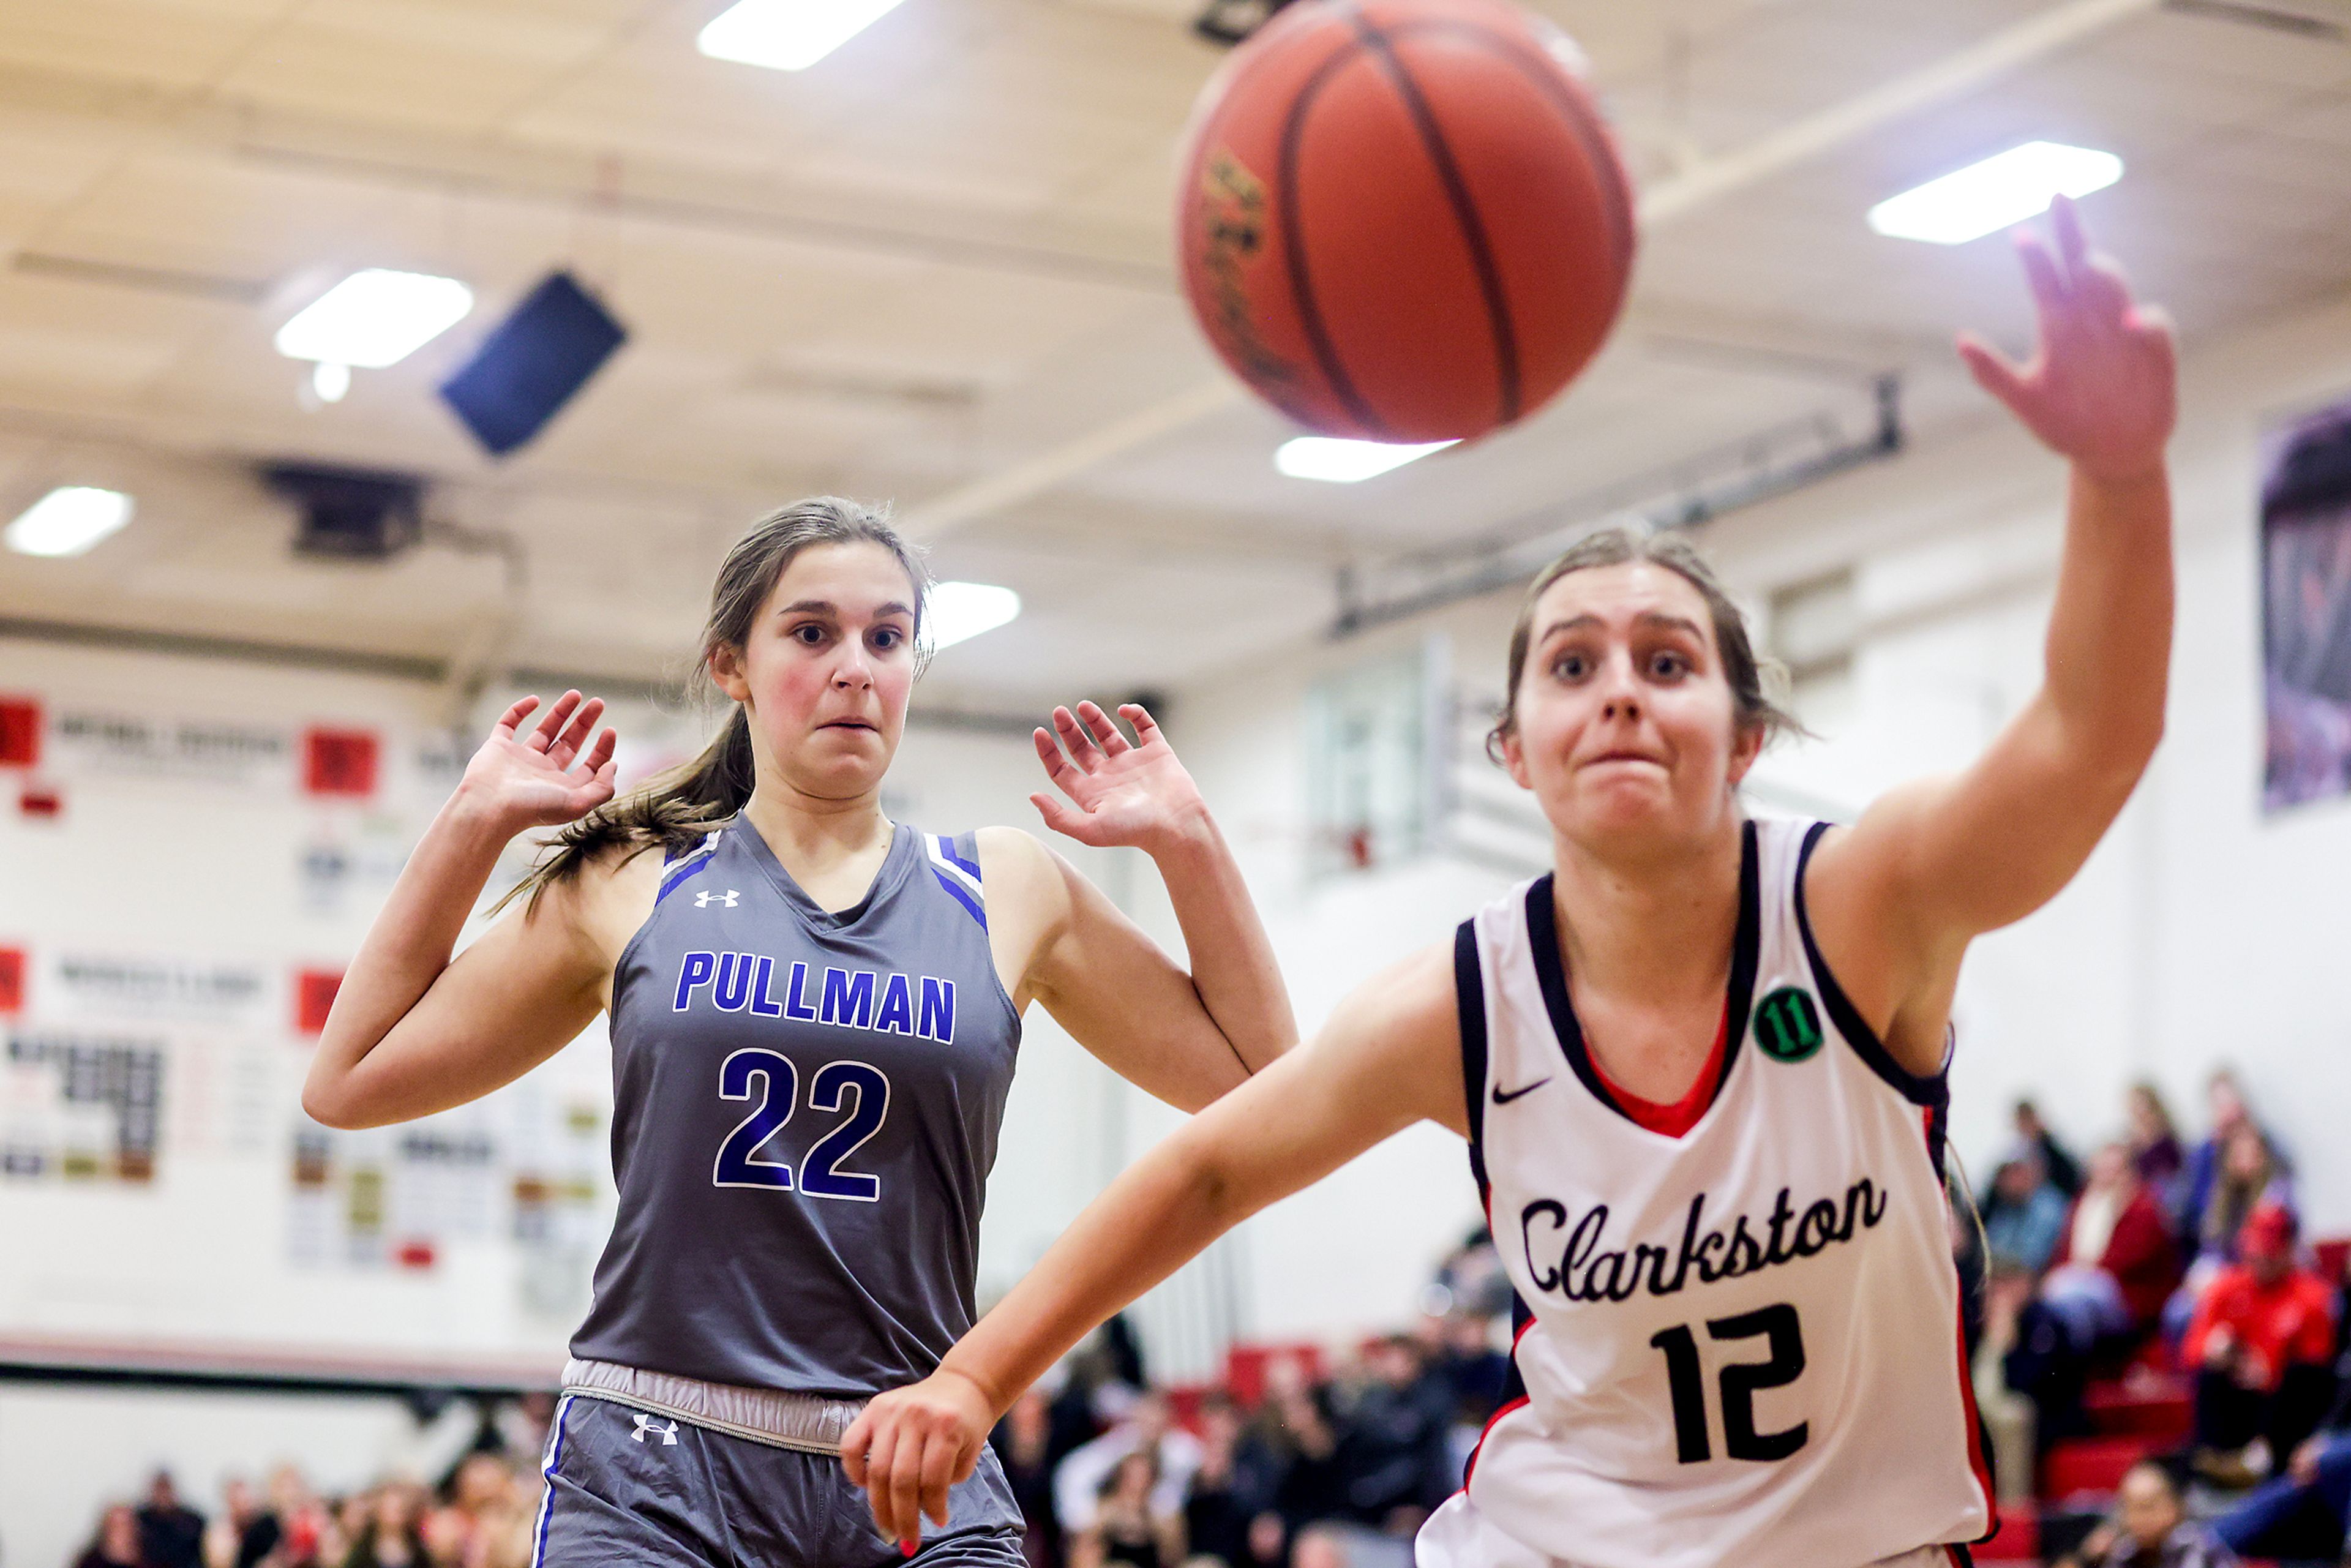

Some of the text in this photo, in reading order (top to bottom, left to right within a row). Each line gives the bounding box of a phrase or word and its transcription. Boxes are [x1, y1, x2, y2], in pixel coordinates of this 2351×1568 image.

[673, 951, 956, 1045] PULLMAN
[1763, 994, 1817, 1054] 11
[713, 1048, 890, 1202] 22
[1521, 1177, 1887, 1302] Clarkston
[1650, 1302, 1809, 1464] 12
